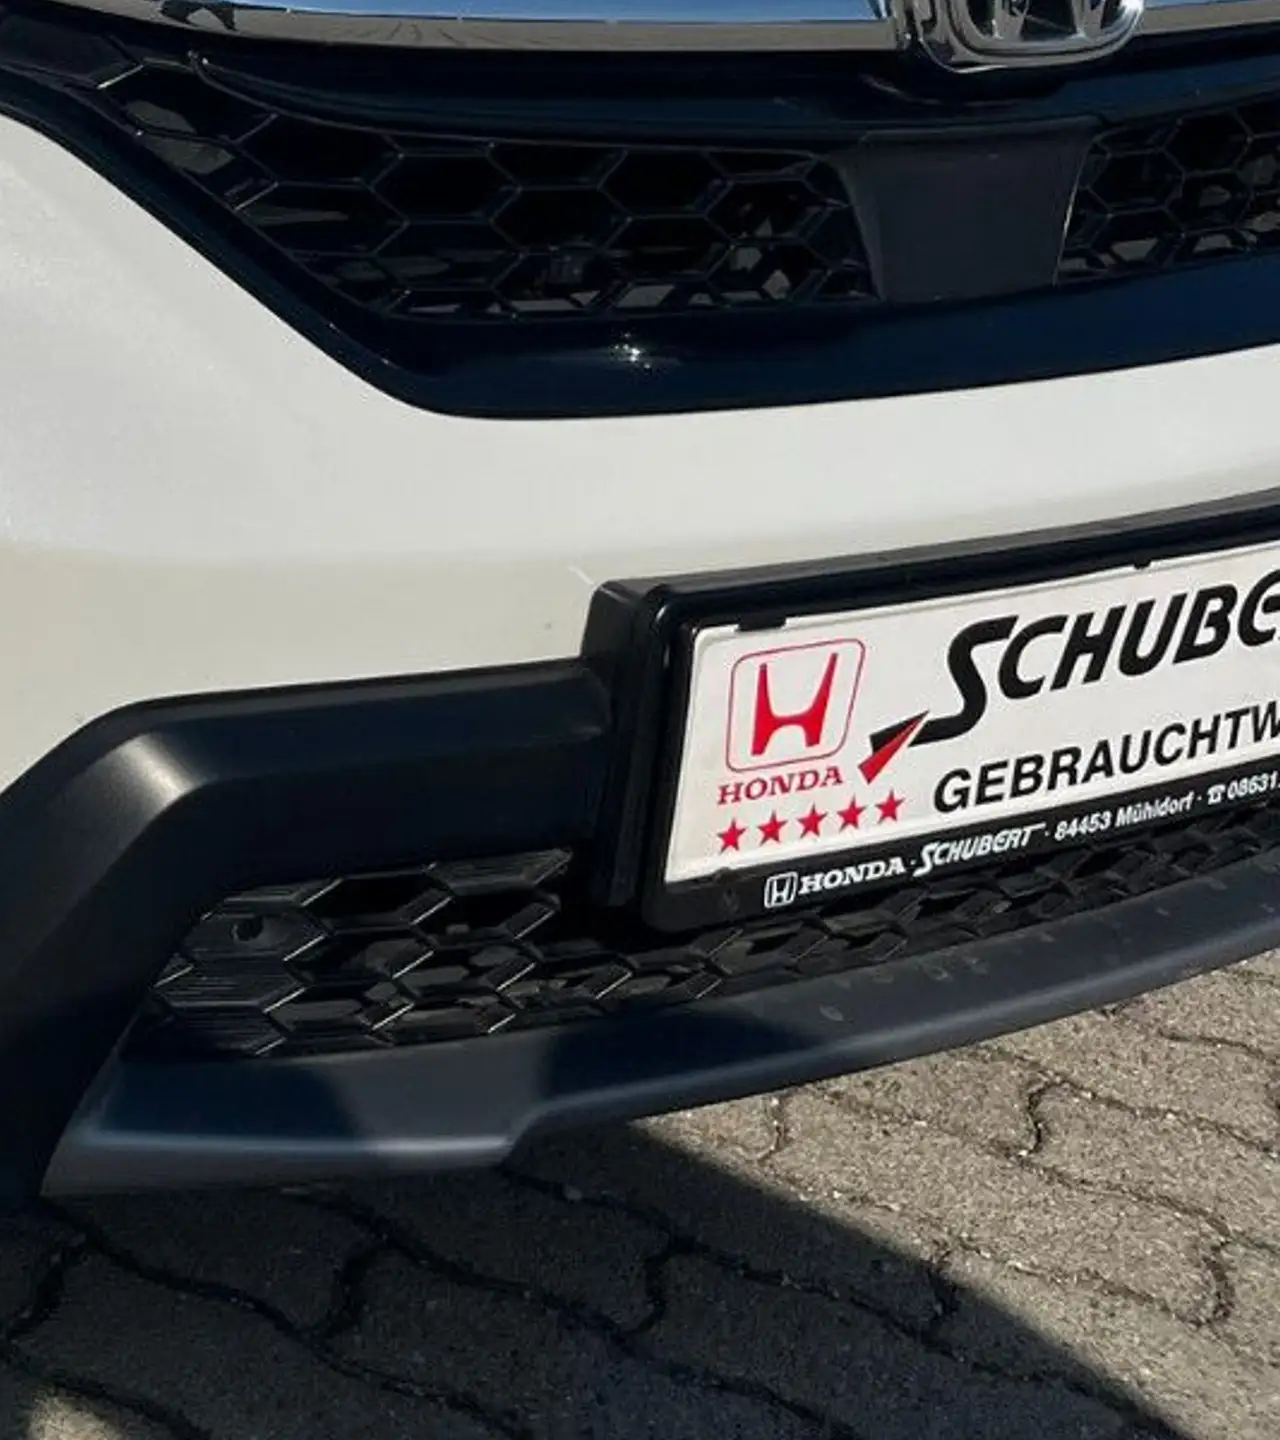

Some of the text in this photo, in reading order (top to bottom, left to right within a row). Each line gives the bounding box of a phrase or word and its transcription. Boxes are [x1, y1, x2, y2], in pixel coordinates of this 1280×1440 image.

[716, 764, 844, 805] HONDA
[799, 857, 907, 896] HONDA
[911, 821, 1047, 878] SCHUBERT
[1053, 810, 1113, 841] 84453
[1114, 790, 1195, 828] Mühldorf
